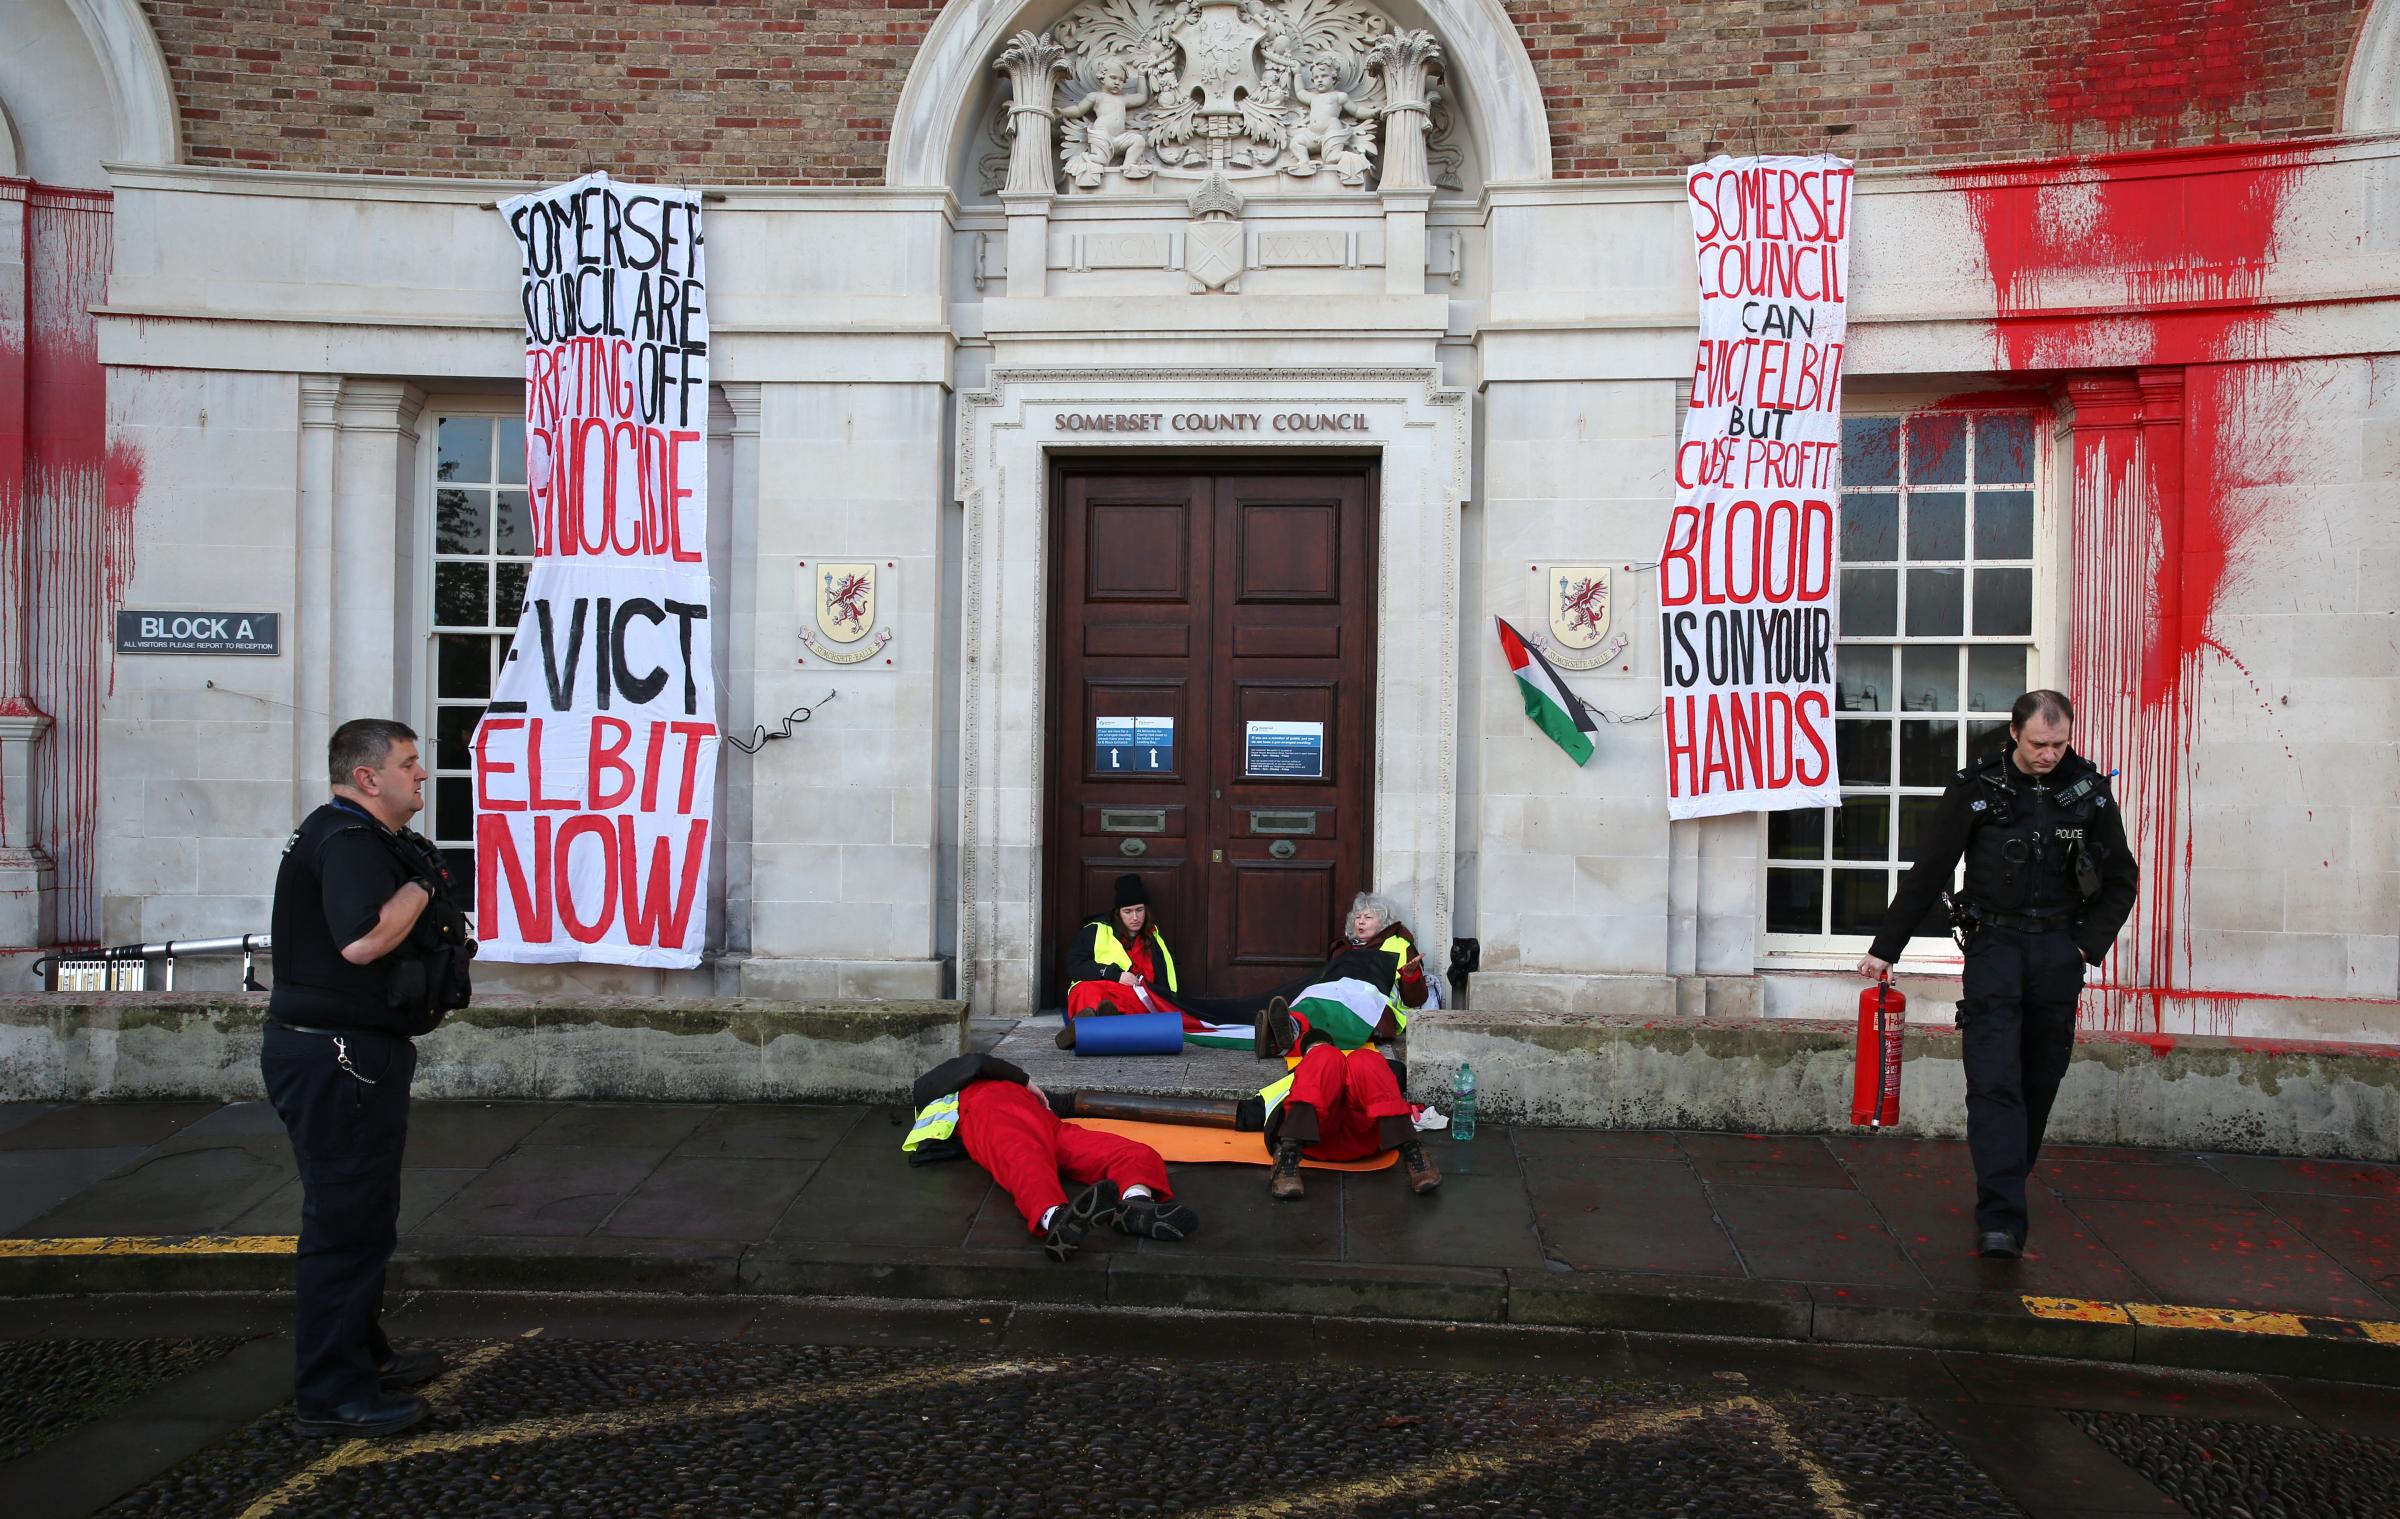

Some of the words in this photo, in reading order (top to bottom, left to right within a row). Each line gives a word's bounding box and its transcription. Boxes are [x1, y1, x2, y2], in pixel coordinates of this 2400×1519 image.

[1688, 168, 1854, 243] SOMERSET
[1699, 242, 1843, 303] COUNCIL
[632, 272, 707, 349] ARE
[1742, 301, 1814, 339] CAN
[638, 342, 707, 427] OFF
[1690, 337, 1760, 408] EVICT
[1757, 339, 1844, 413] ELBIT
[1055, 412, 1164, 432] SOMERSET
[1171, 412, 1262, 432] COUNTY
[1272, 412, 1369, 432] COUNCIL
[1728, 405, 1793, 441] BUT
[1744, 438, 1838, 489] PROFIT
[1660, 499, 1834, 606] BLOOD
[141, 617, 229, 640] BLOCK
[236, 619, 255, 640] A
[169, 641, 195, 649] PLEASE
[1662, 610, 1700, 687] IS
[1705, 609, 1755, 686] ON
[1756, 607, 1831, 685] YOUR
[476, 716, 716, 814] ELBIT
[1665, 690, 1830, 797] HANDS
[2055, 828, 2083, 839] POLICE
[476, 813, 708, 949] NOW
